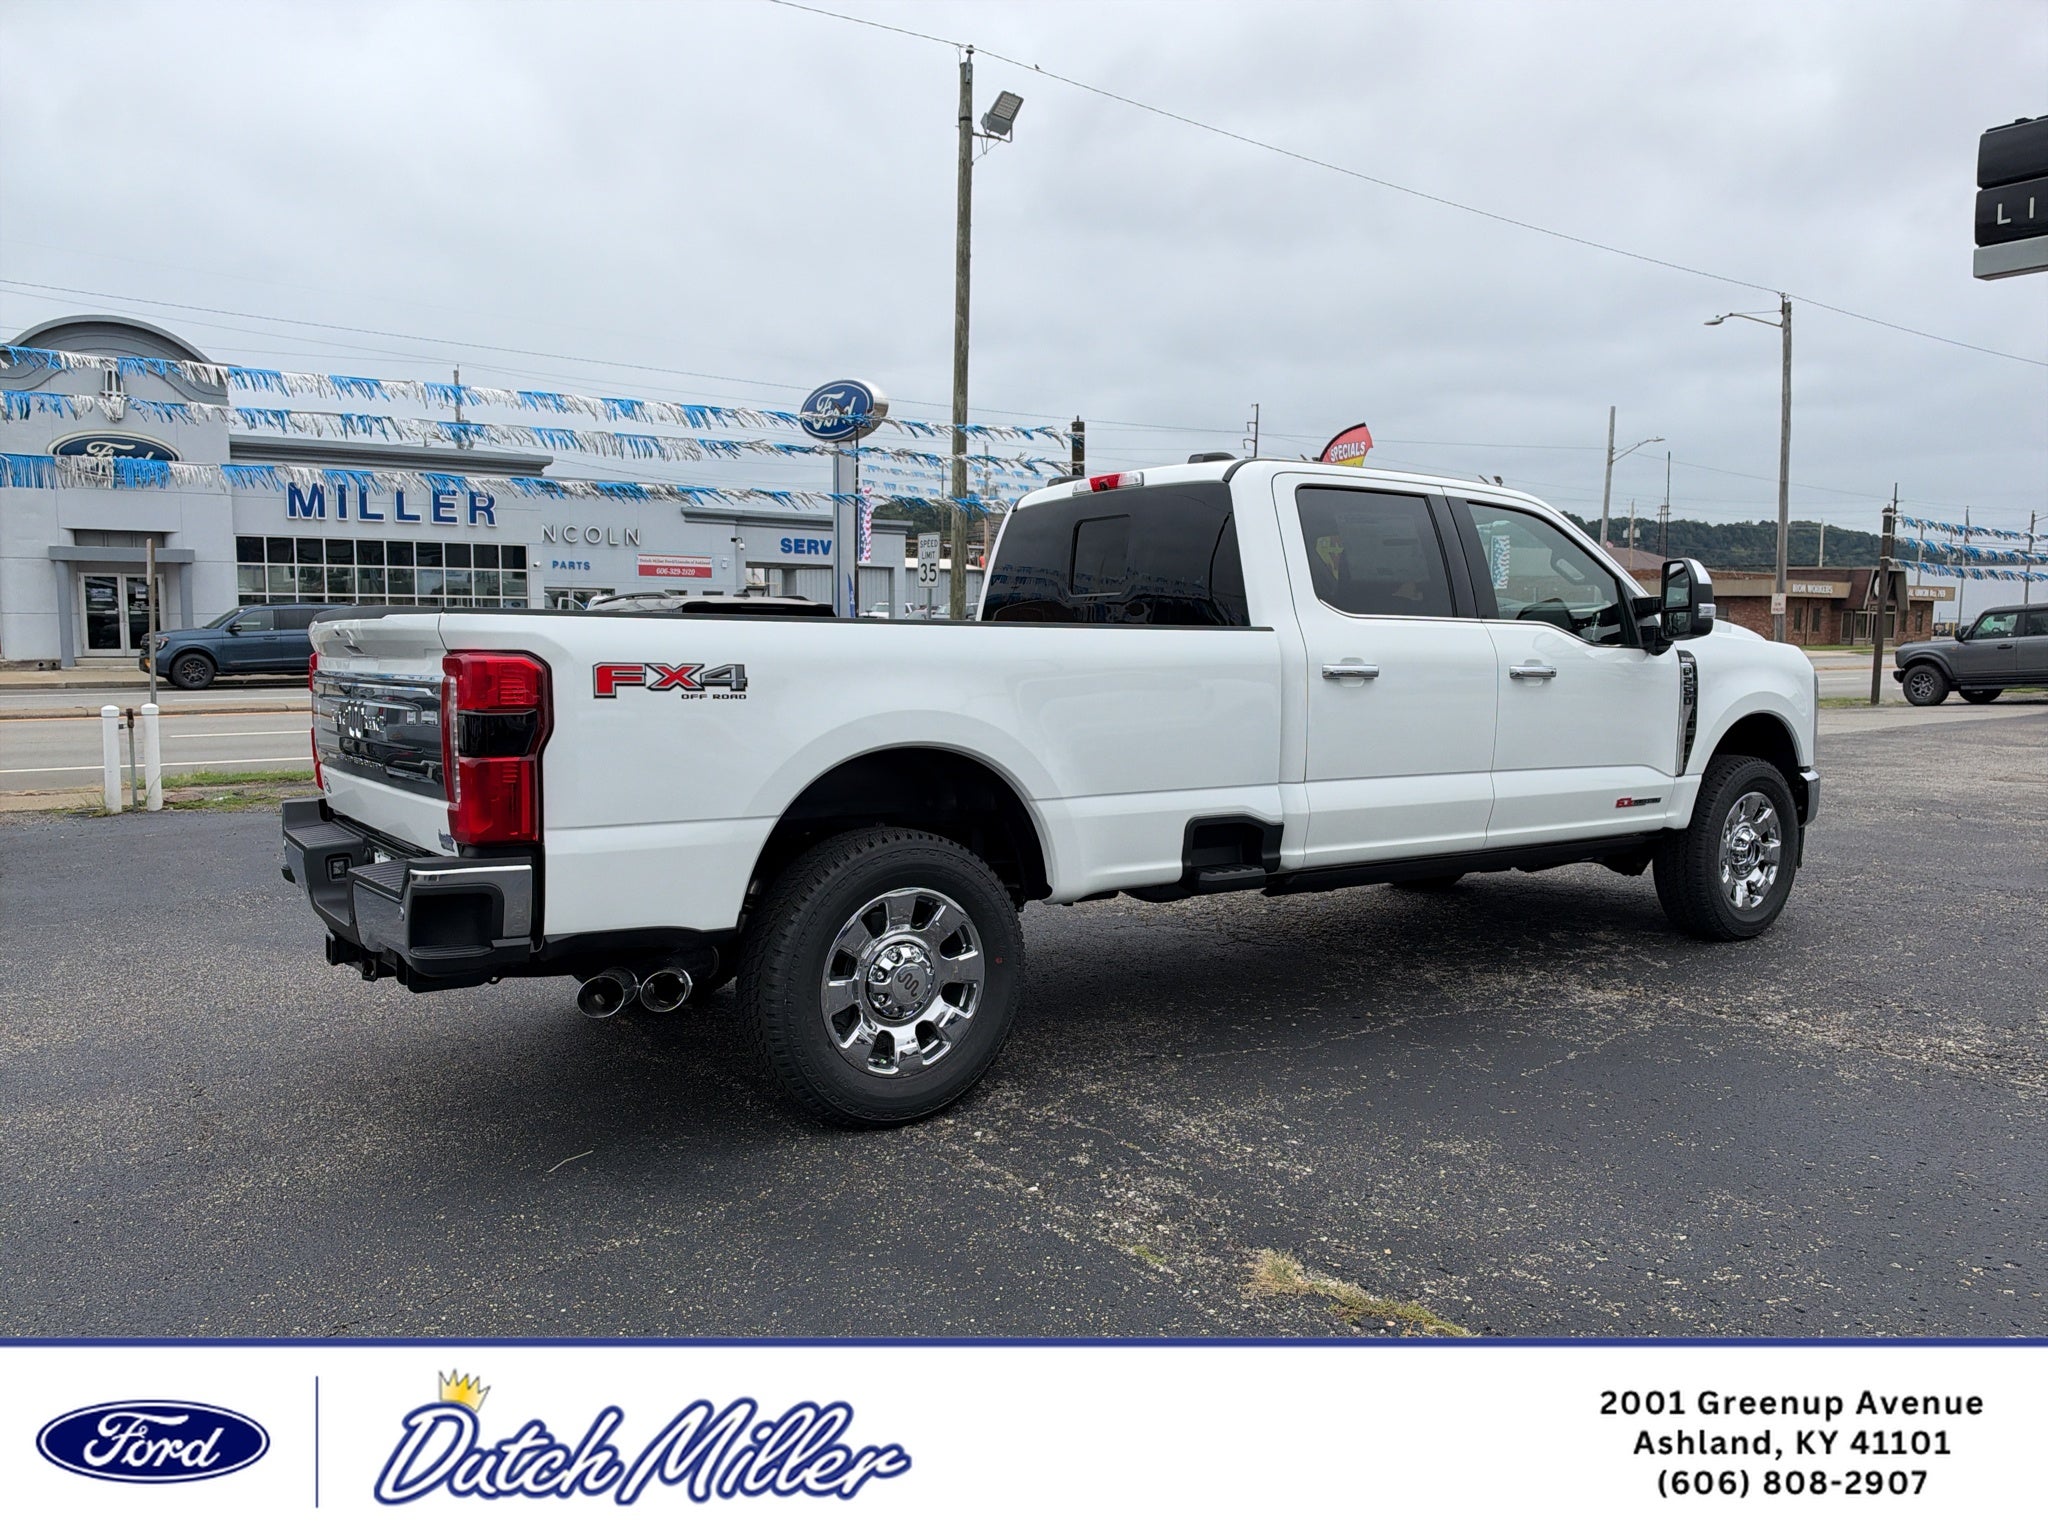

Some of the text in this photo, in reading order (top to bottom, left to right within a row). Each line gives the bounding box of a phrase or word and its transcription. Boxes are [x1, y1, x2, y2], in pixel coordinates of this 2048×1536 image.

[1330, 441, 1366, 463] SPECIALS
[286, 481, 498, 528] MILLER
[780, 537, 833, 555] SERV
[920, 539, 939, 548] SPEED
[921, 551, 936, 560] LIMIT
[552, 560, 591, 571] PARTS
[920, 563, 937, 582] 35
[592, 662, 748, 699] FX4
